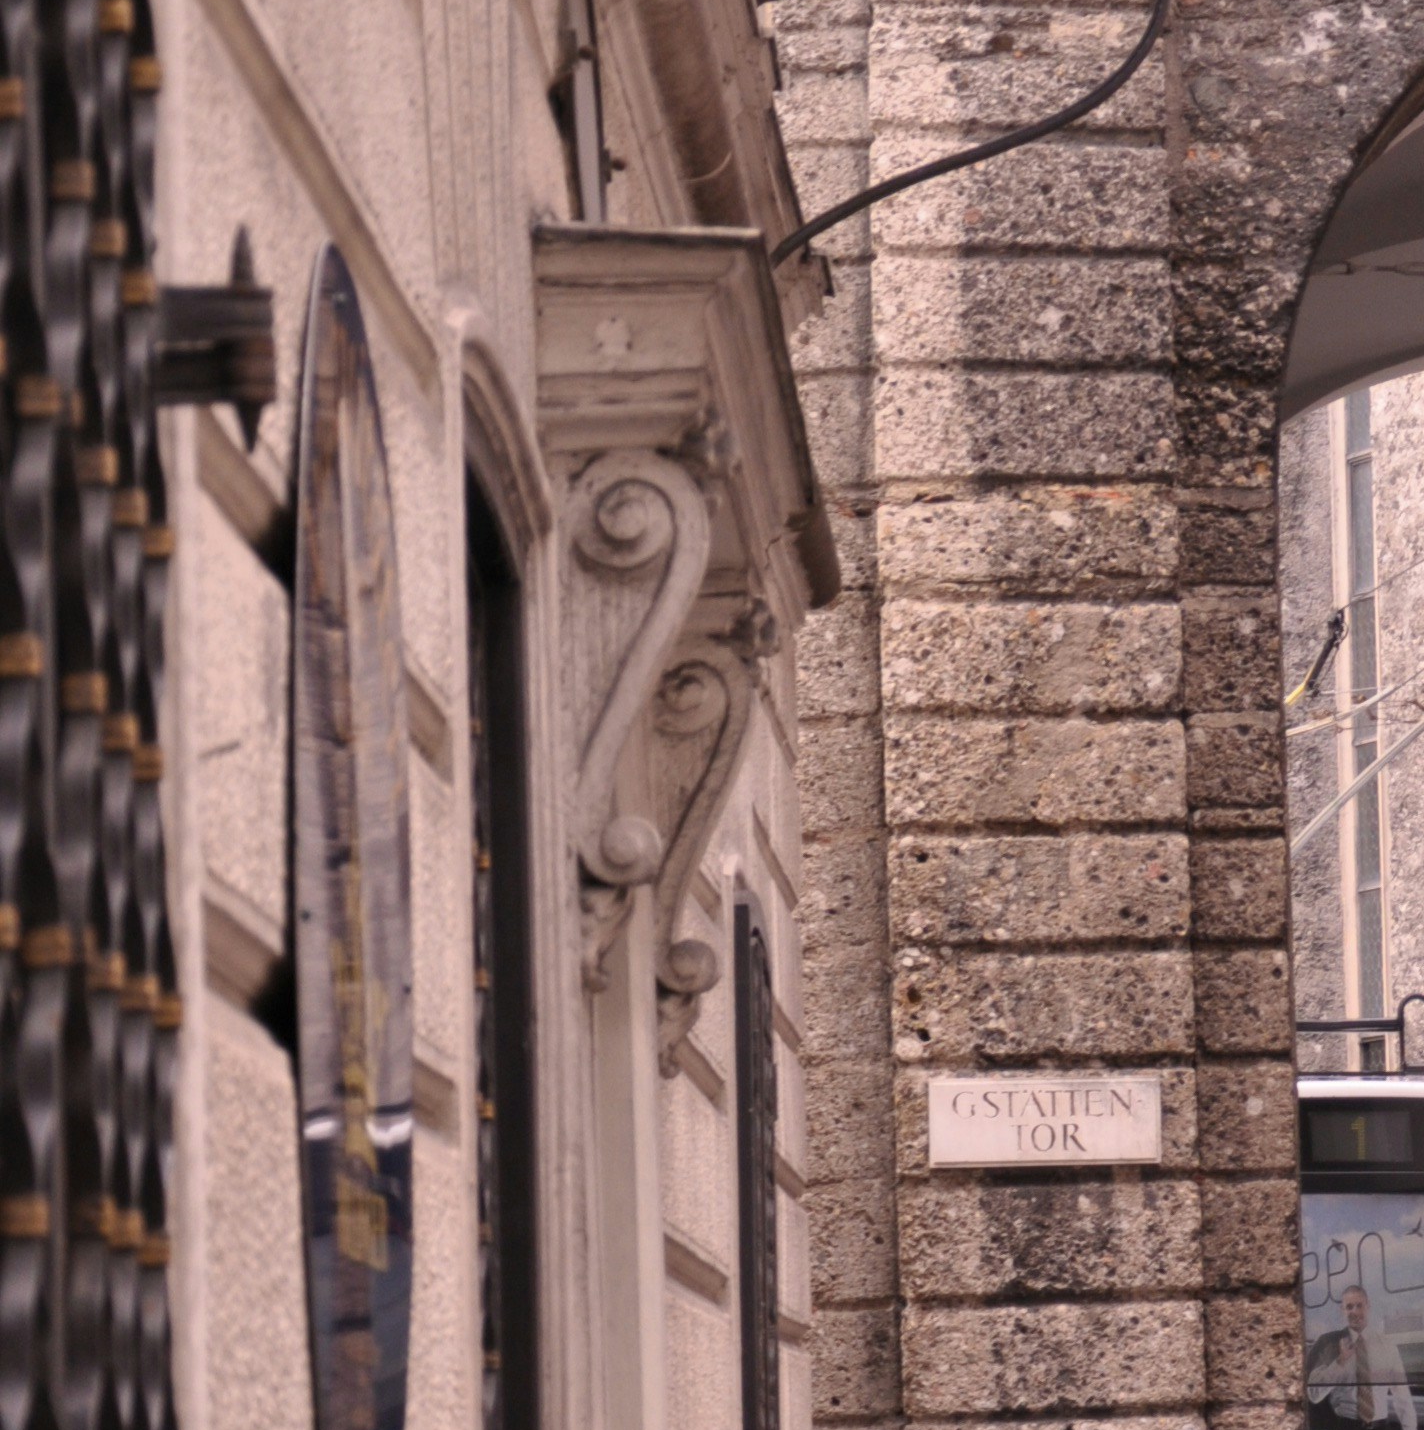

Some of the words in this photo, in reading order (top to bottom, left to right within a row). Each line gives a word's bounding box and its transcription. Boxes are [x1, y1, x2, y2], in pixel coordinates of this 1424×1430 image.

[951, 1089, 1143, 1119] GSTÄTTEN-
[1010, 1123, 1087, 1153] TOR
[1351, 1116, 1367, 1160] 1
